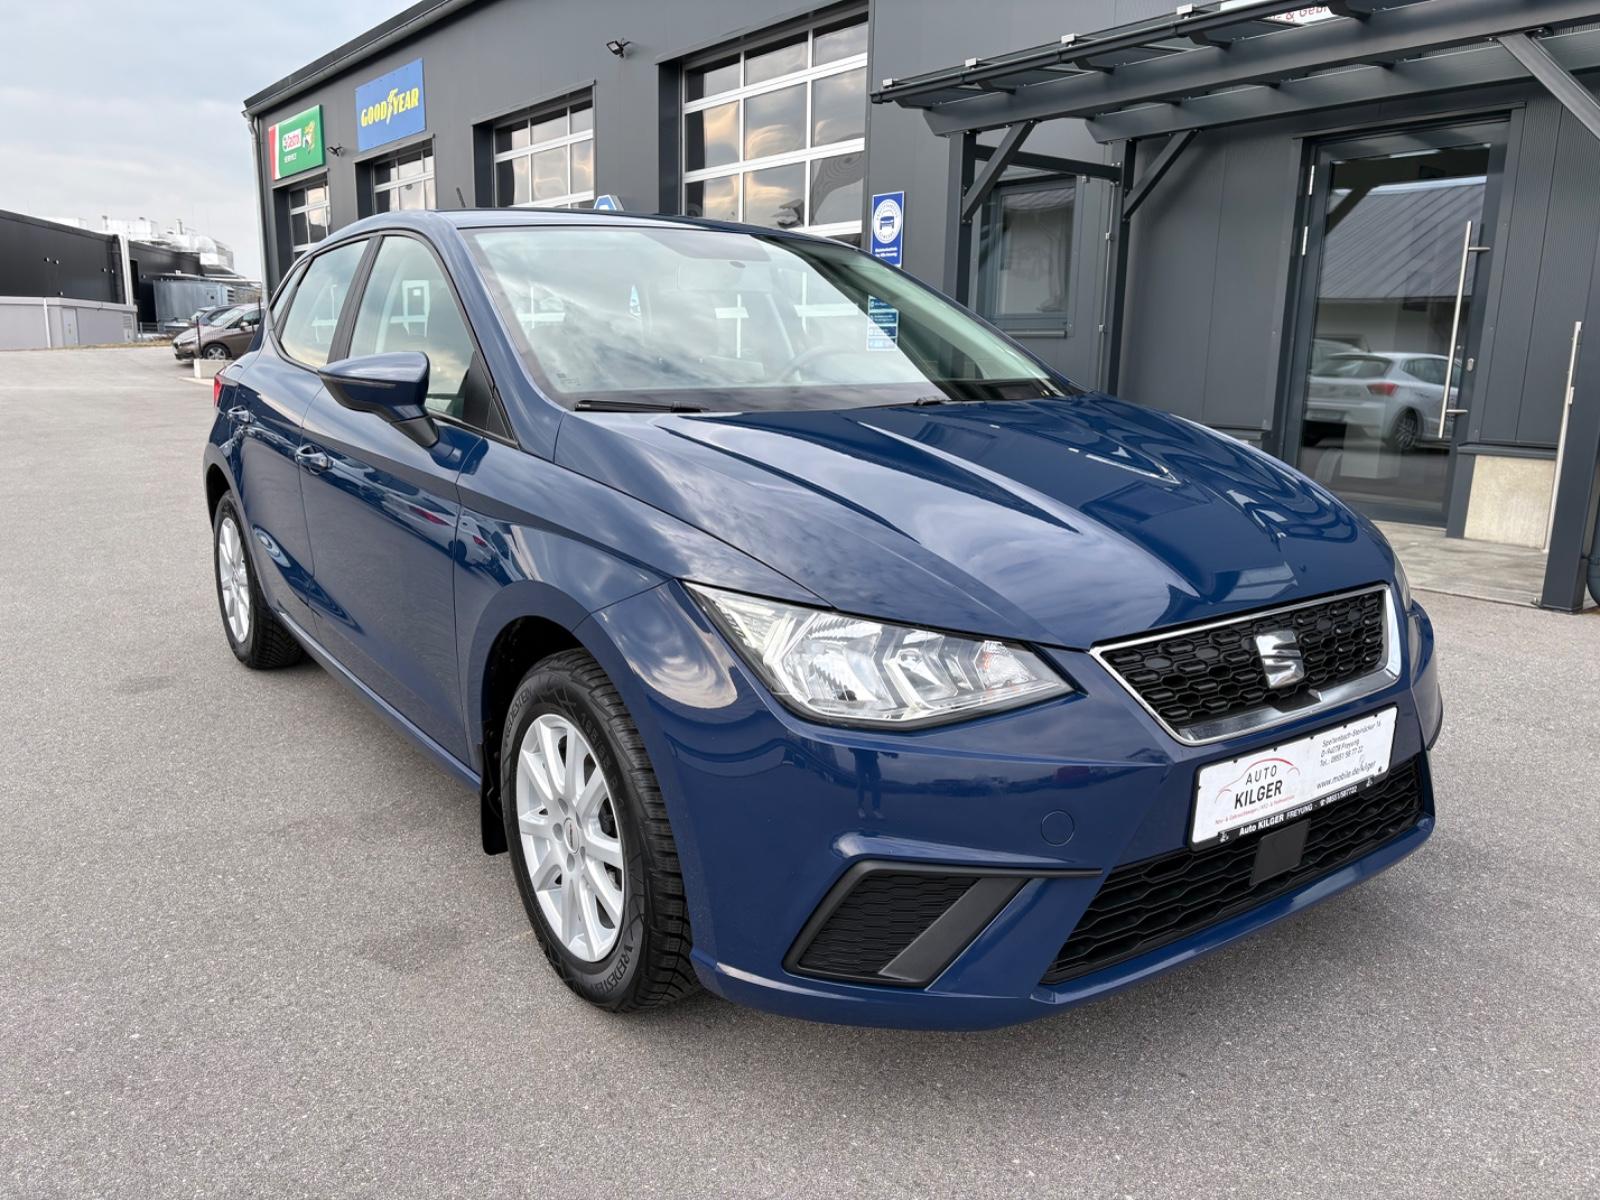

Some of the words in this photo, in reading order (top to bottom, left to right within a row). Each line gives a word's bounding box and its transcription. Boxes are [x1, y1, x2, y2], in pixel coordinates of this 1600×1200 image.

[361, 88, 419, 127] GOODYEAR
[1245, 764, 1277, 785] AUTO
[1234, 779, 1283, 809] KILGER
[1239, 824, 1257, 836] Auto
[1257, 814, 1285, 829] KILGER
[1286, 803, 1313, 819] FREYUNG
